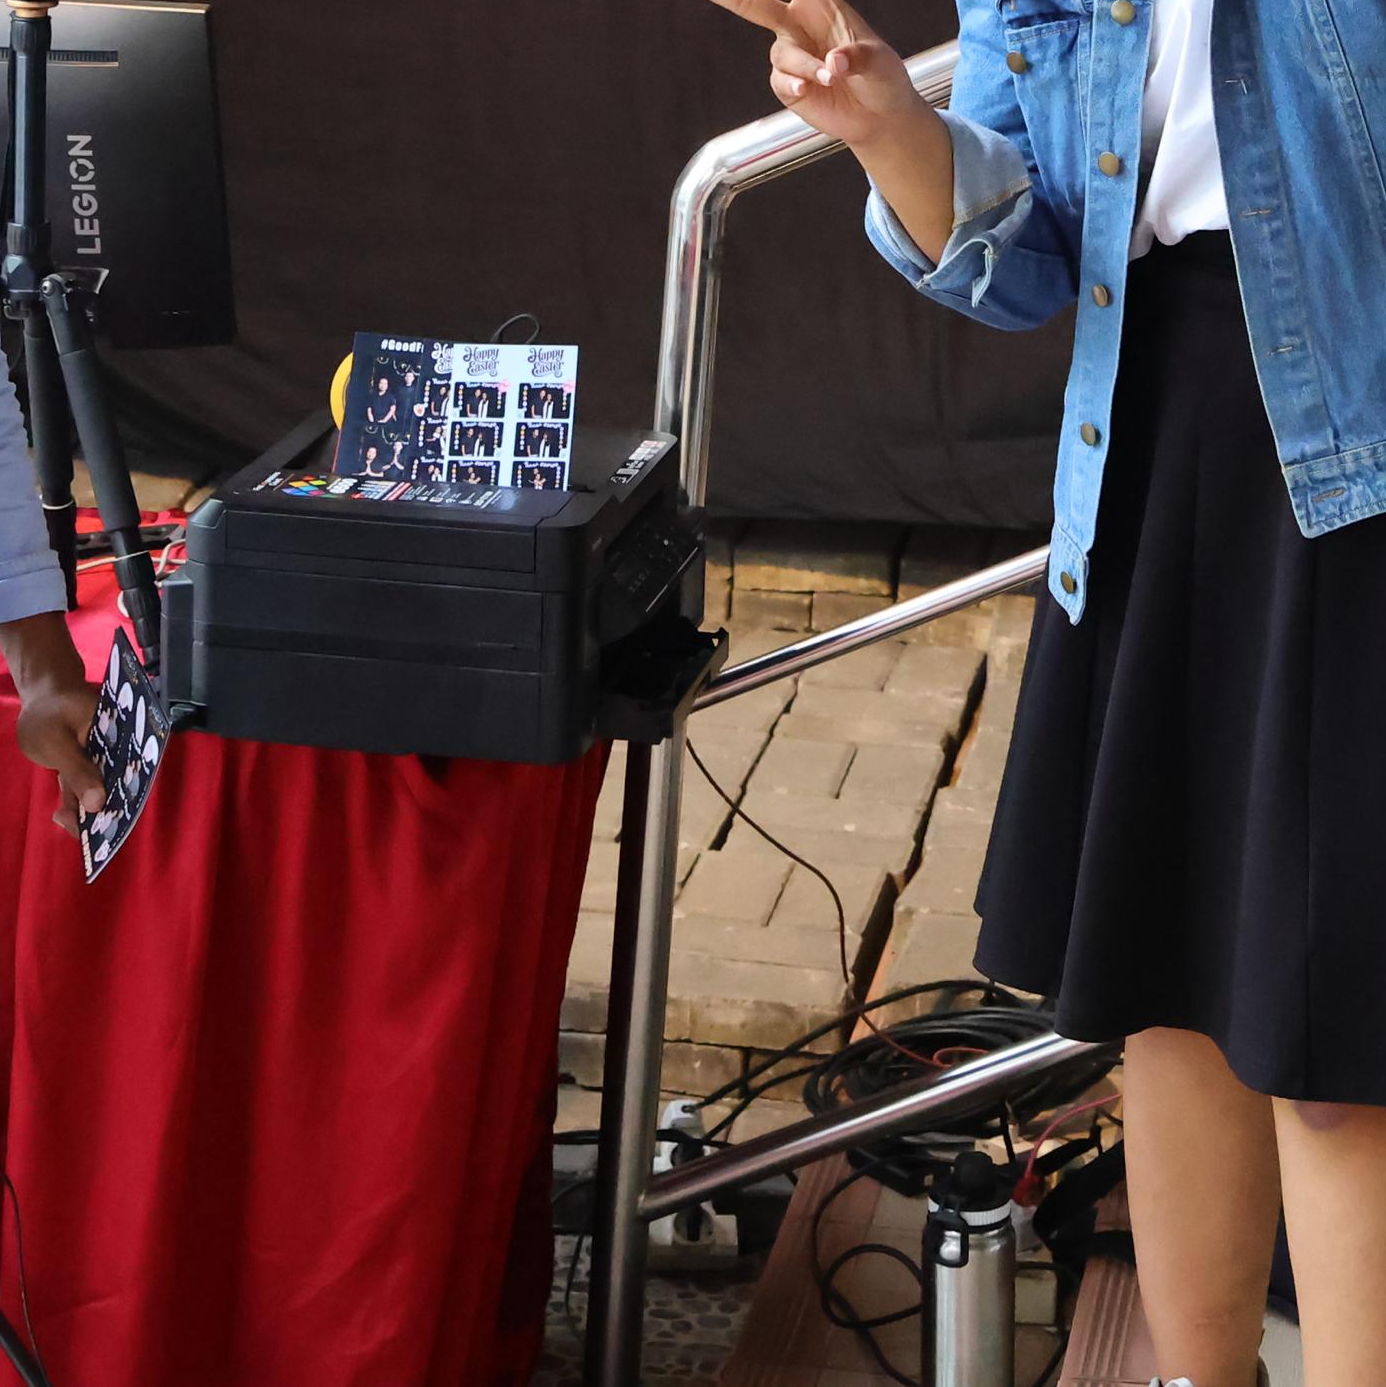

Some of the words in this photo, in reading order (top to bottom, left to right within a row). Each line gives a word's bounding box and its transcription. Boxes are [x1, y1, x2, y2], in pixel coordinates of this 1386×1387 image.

[66, 134, 102, 255] LEGION
[463, 345, 500, 362] Happy
[527, 346, 564, 364] Happy
[467, 360, 500, 377] Easter
[531, 361, 565, 379] Easter
